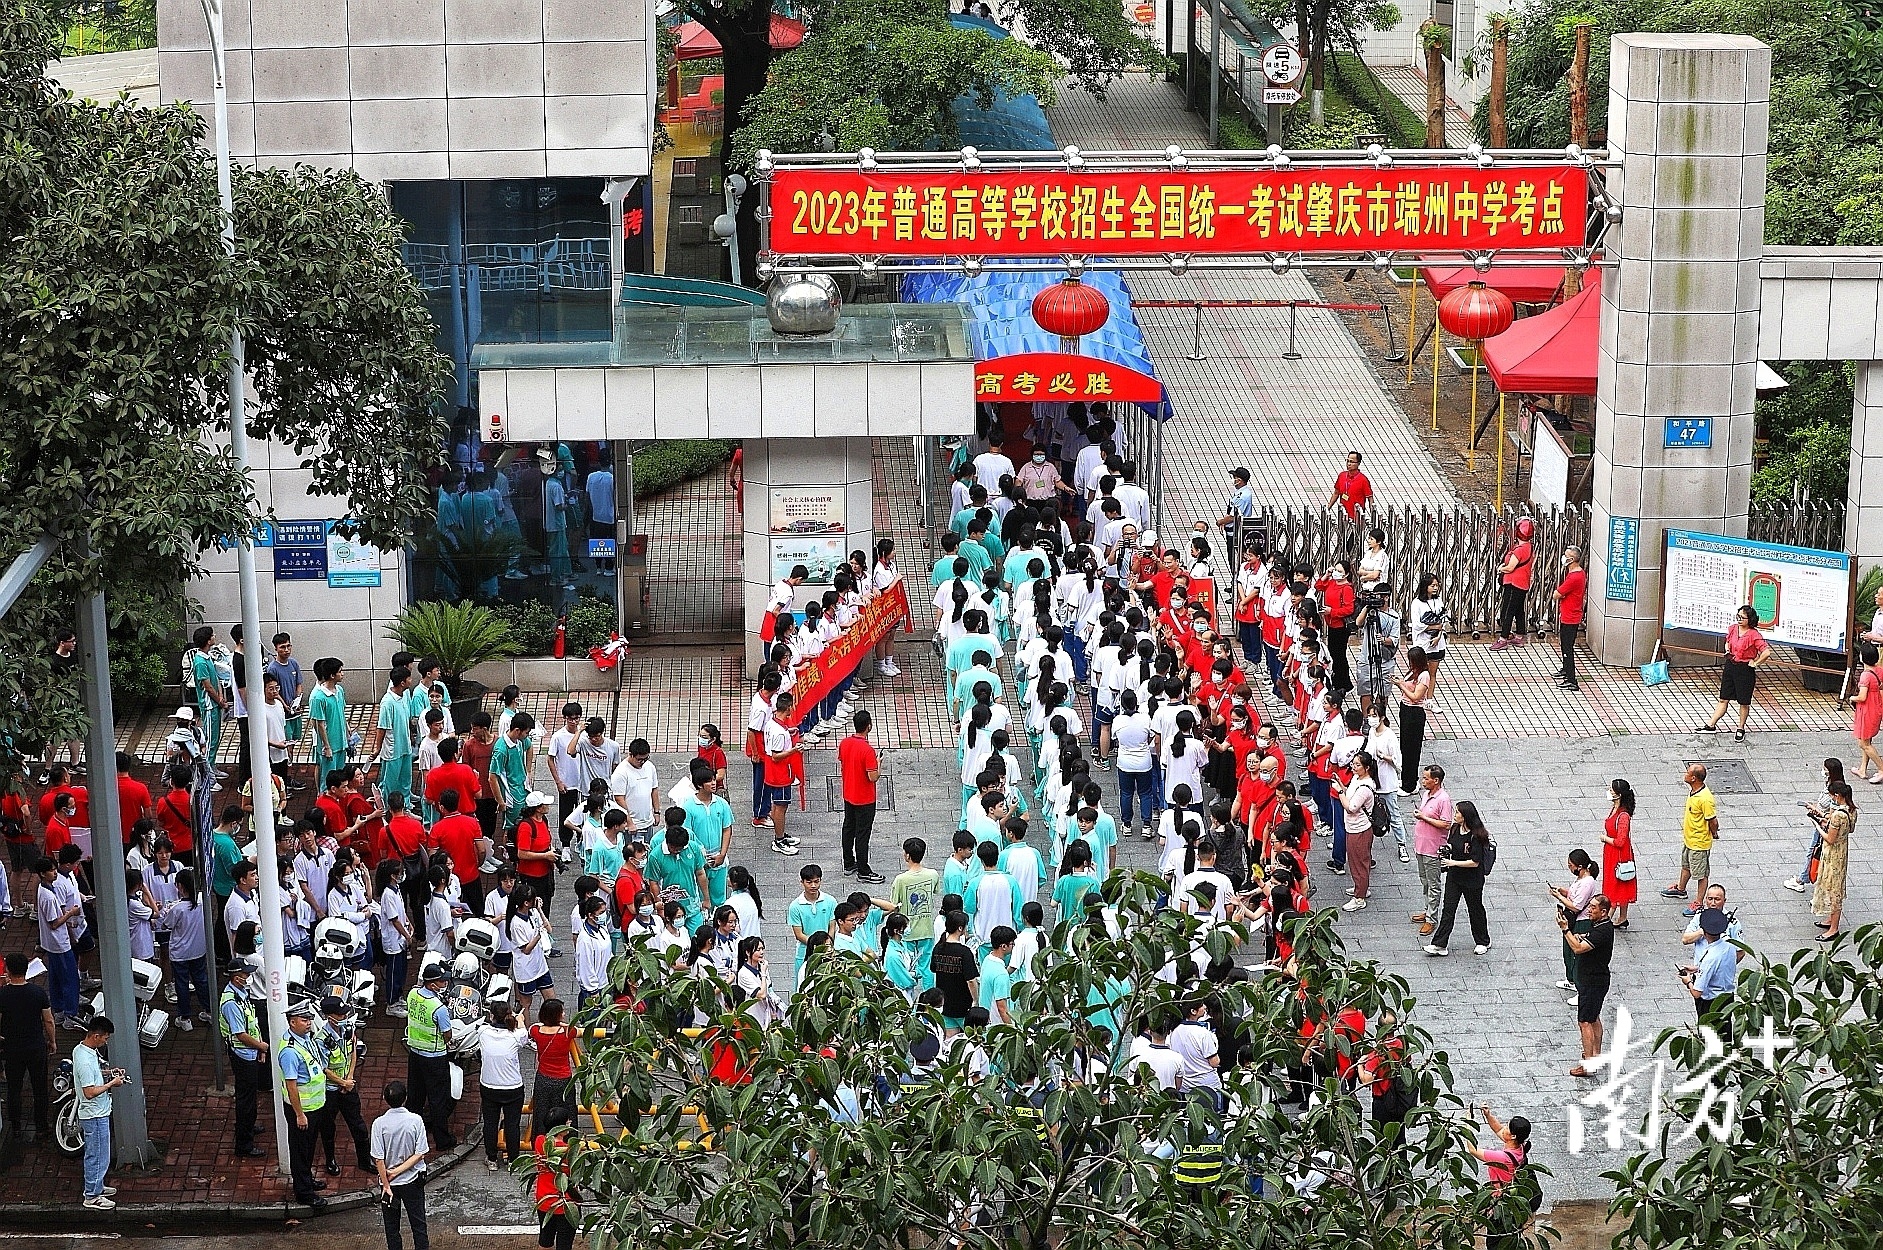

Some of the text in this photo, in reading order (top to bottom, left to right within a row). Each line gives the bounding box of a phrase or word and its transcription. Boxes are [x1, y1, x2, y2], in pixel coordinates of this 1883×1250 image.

[792, 181, 1565, 241] 2023年普通高等学校招生全国统一考试肇庆市端州中学考点
[975, 372, 1113, 395] 高考必胜
[1680, 428, 1697, 440] 47
